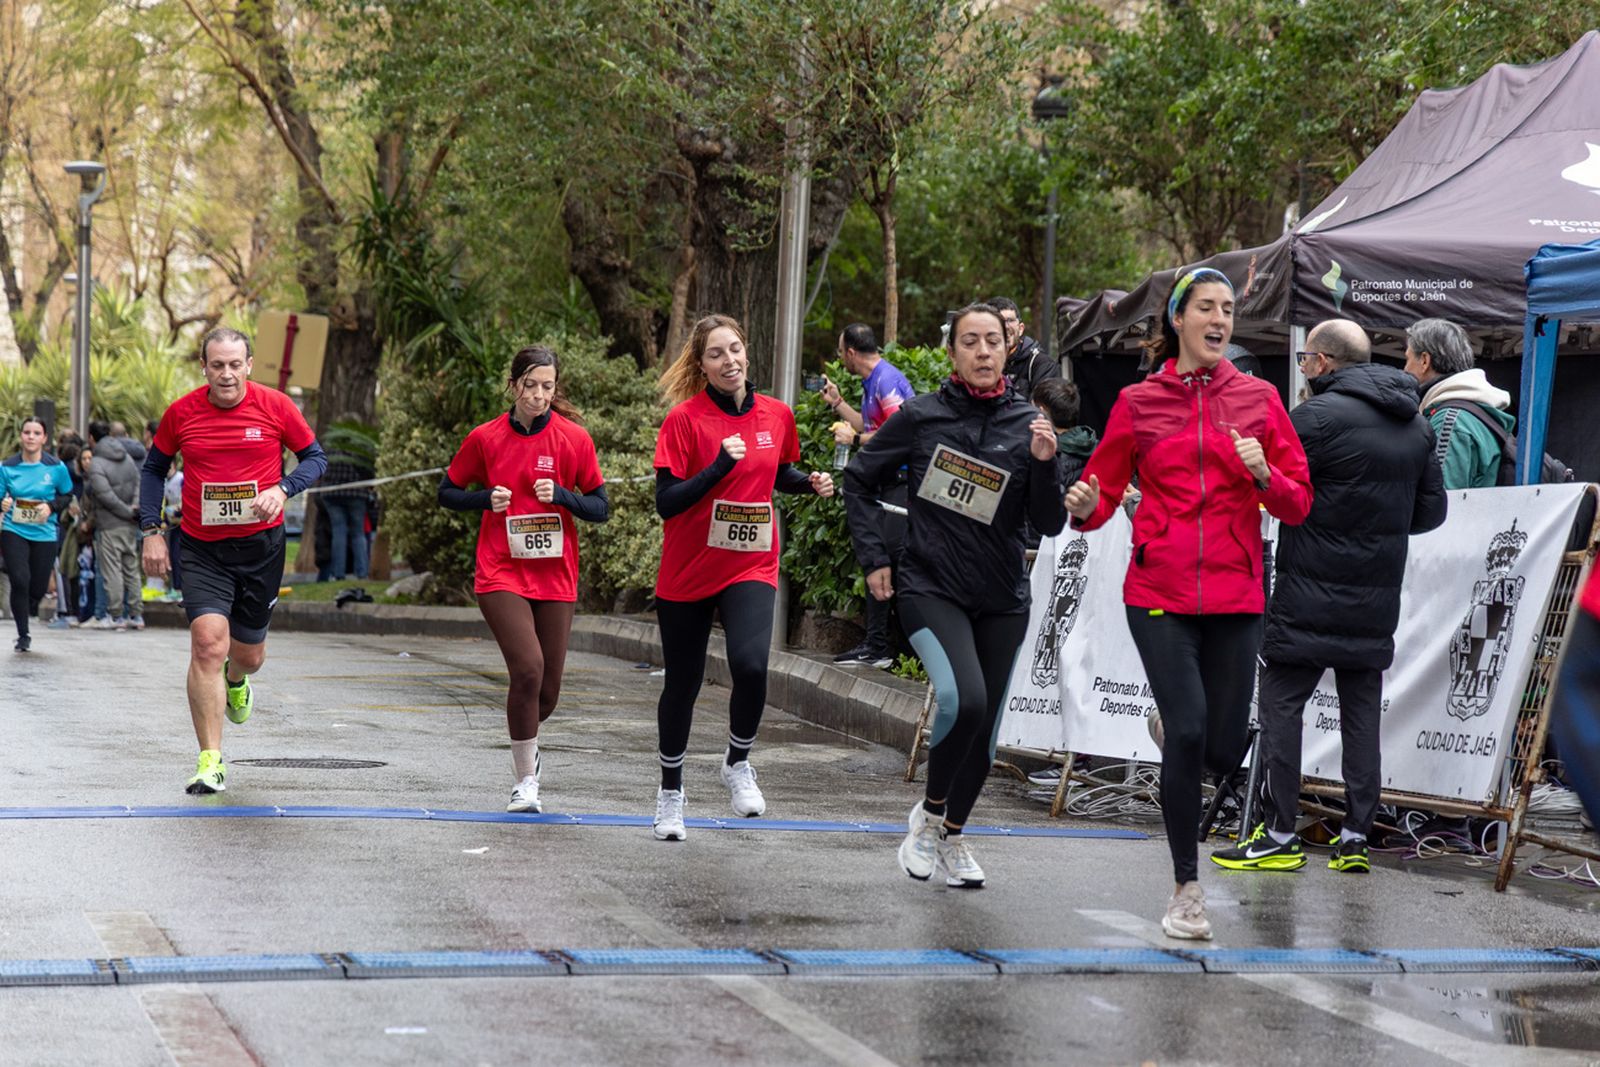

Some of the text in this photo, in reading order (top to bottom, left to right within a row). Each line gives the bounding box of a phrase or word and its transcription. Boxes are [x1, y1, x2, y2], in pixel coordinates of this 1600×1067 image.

[1351, 279, 1474, 292] Patronato Municipal de
[1352, 290, 1447, 303] Deportes de Jaén
[971, 472, 1000, 490] POPULAR
[948, 479, 975, 504] 611
[219, 501, 242, 516] 314
[722, 512, 748, 522] CARRERA
[525, 533, 552, 549] 665
[728, 523, 758, 542] 666
[1093, 676, 1139, 697] Patronato
[1035, 699, 1046, 715] DE
[1100, 697, 1142, 718] Deportes
[1416, 730, 1497, 757] CIUDAD DE JAÉN
